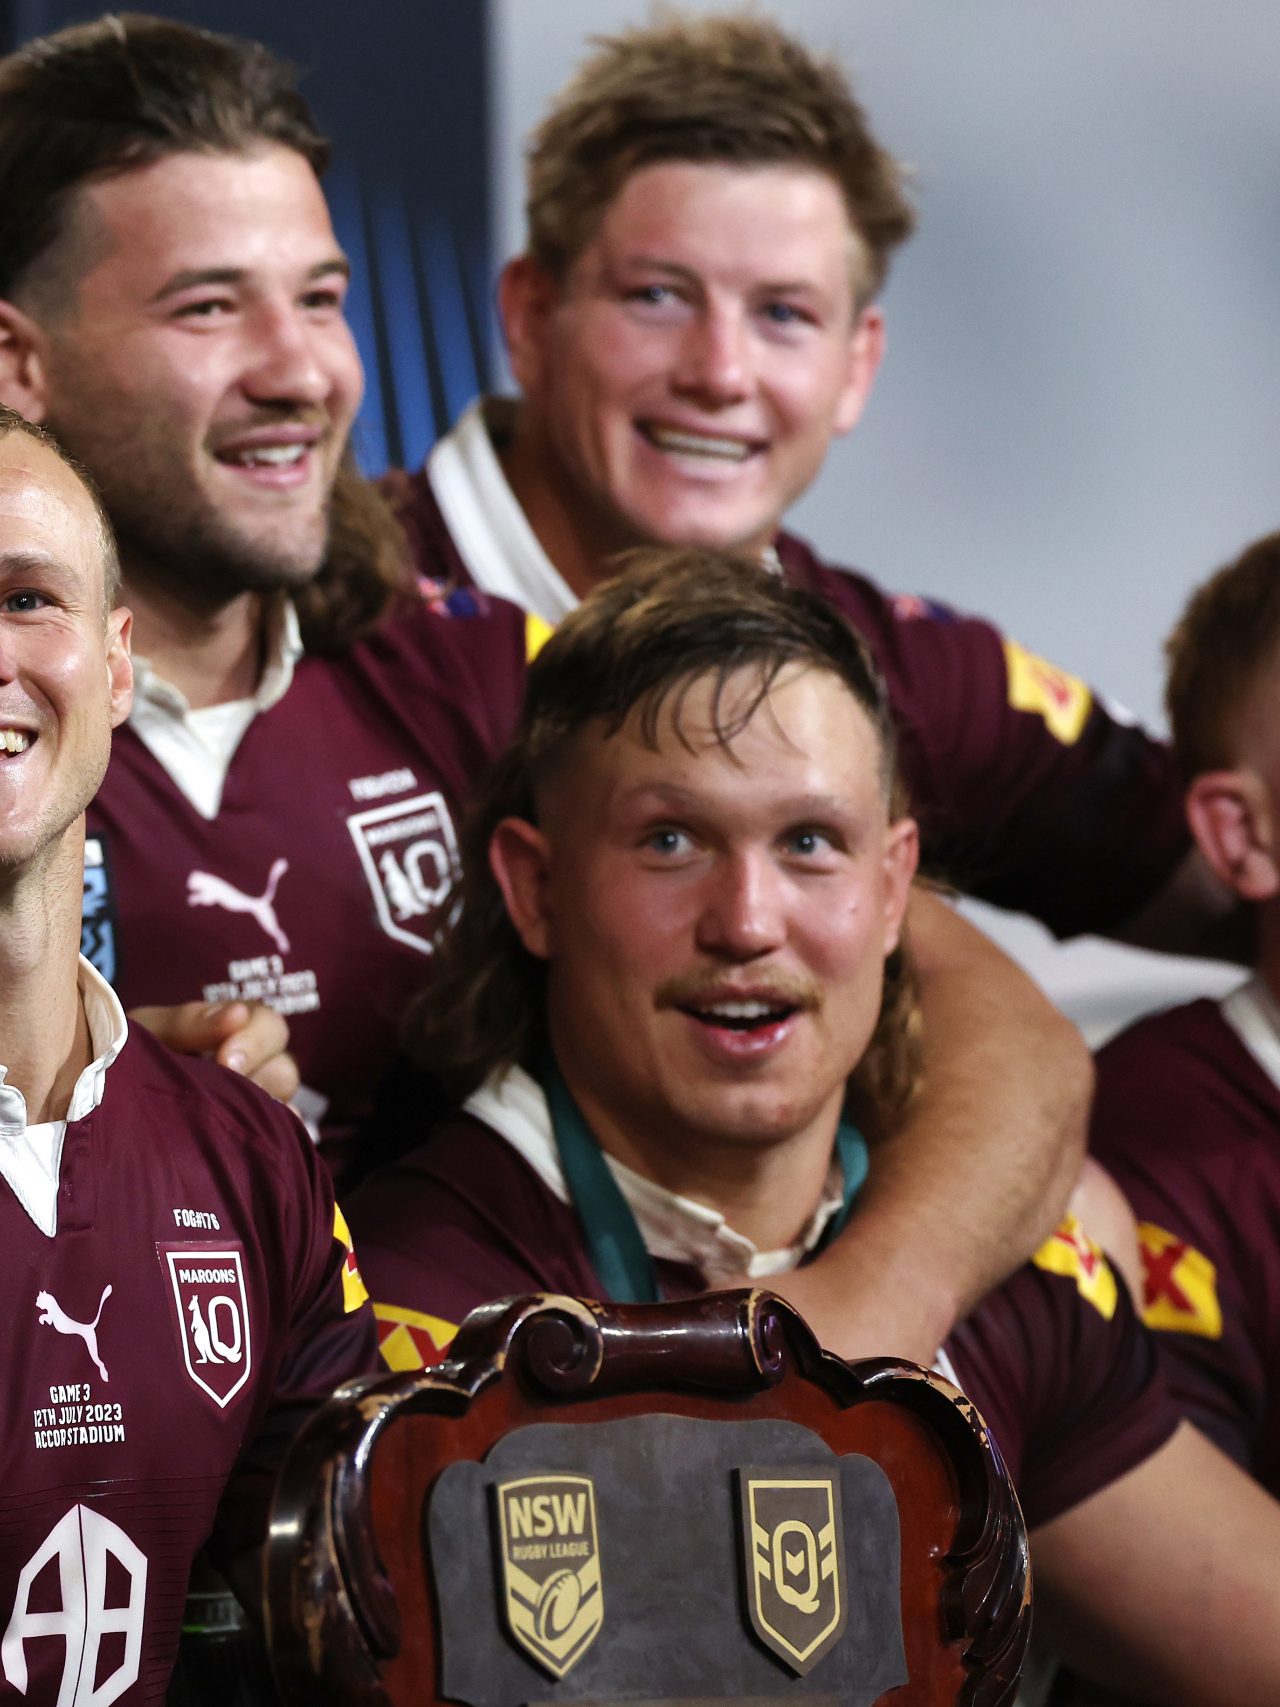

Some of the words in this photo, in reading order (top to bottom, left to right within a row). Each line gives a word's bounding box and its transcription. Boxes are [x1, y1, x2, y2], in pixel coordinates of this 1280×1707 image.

[173, 1208, 220, 1231] FOG#176
[179, 1269, 236, 1284] MAROONS
[49, 1384, 81, 1404] GAME
[83, 1383, 91, 1402] 3
[33, 1408, 57, 1428] 12TH
[58, 1405, 83, 1425] JULY
[85, 1403, 123, 1423] 2023
[34, 1428, 67, 1449] ACCOR
[67, 1424, 125, 1446] STADIUM
[508, 1492, 587, 1539] NSW
[549, 1541, 590, 1559] LEAGUE
